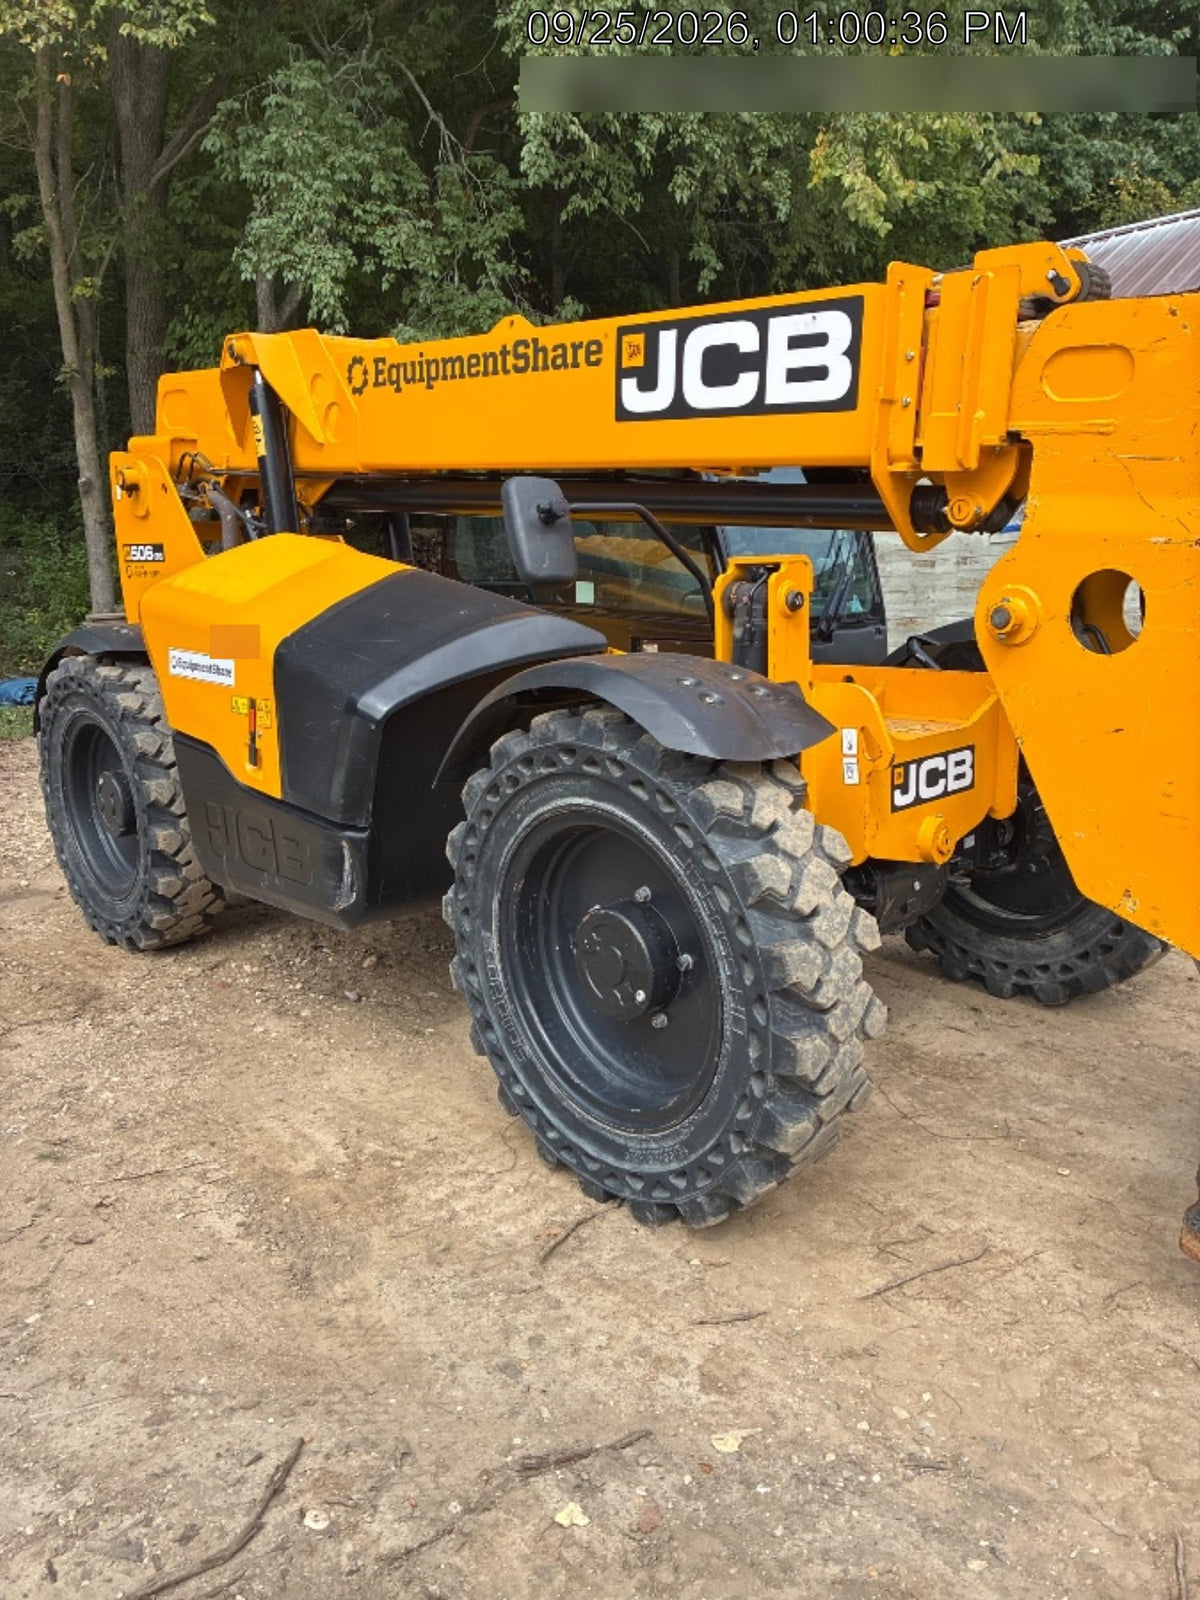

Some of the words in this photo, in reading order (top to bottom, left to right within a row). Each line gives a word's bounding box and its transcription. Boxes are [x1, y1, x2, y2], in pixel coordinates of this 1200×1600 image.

[372, 337, 604, 394] EquipmentShare
[620, 309, 853, 414] JCB
[893, 749, 974, 807] JCB
